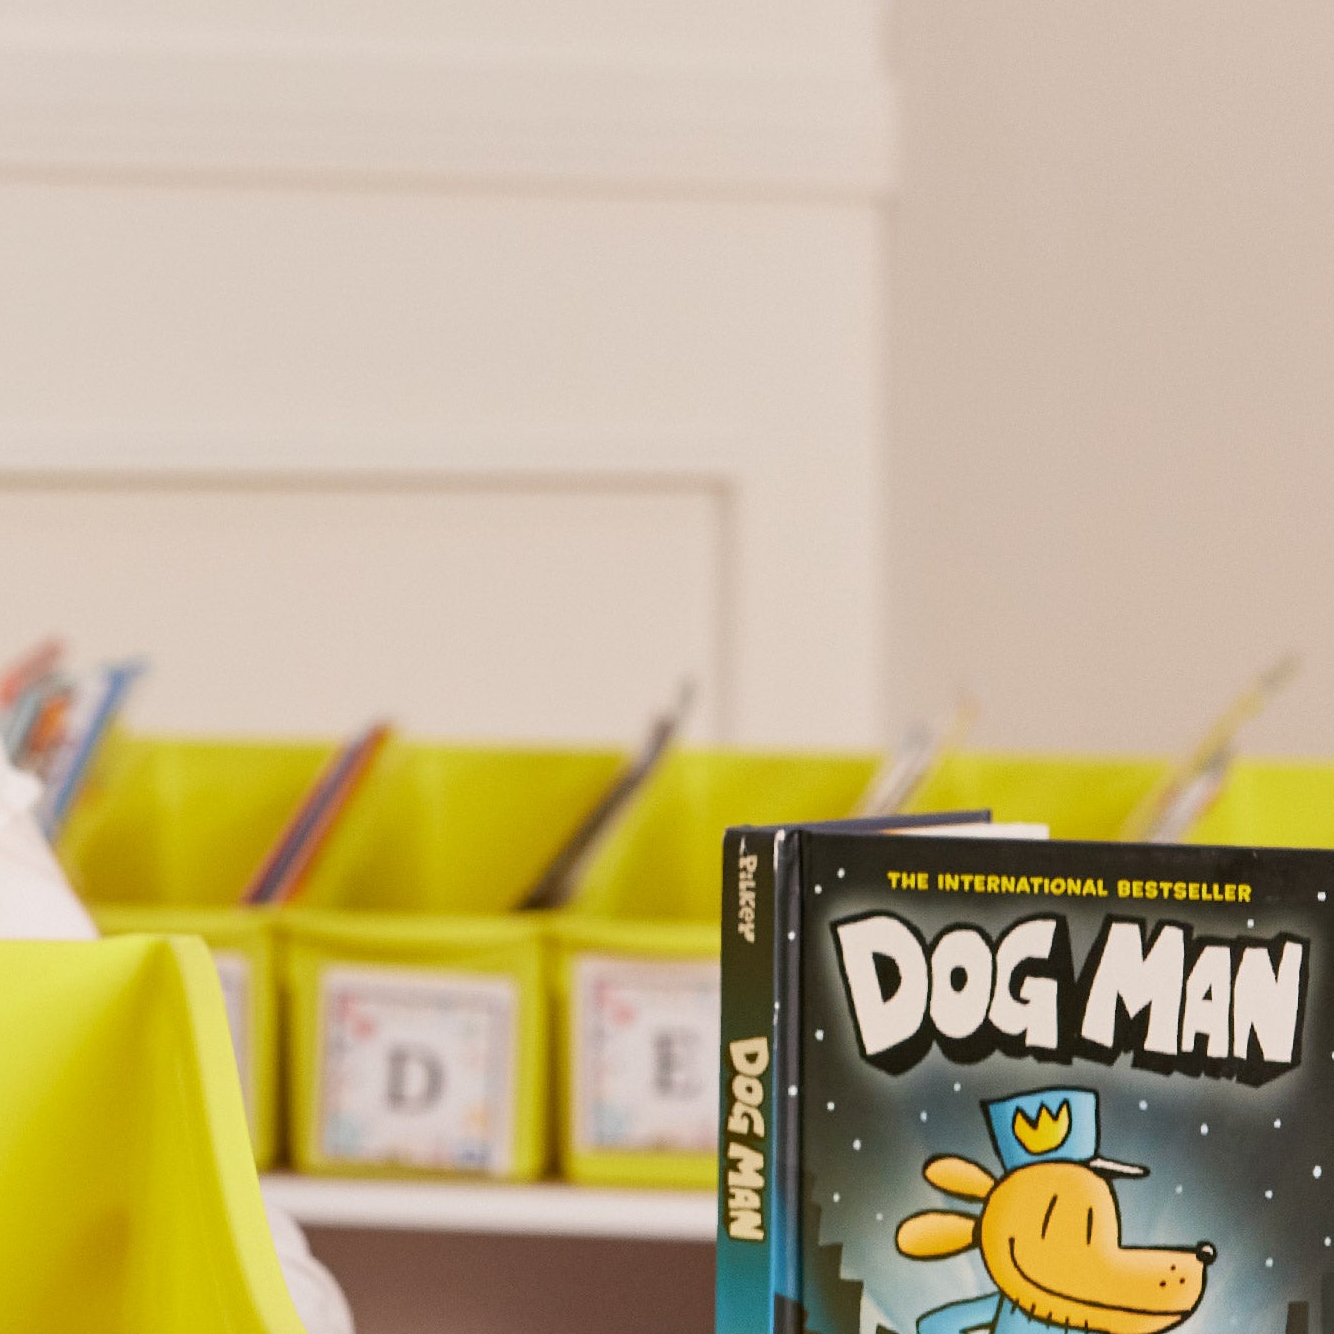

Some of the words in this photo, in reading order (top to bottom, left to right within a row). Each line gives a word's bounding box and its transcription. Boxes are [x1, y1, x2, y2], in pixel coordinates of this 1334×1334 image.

[888, 872, 929, 892] THE
[937, 873, 1108, 898] INTERNATIONAL
[1117, 880, 1253, 903] BESTSELLER
[836, 916, 1058, 1057] DOG
[1081, 919, 1304, 1064] MAN
[386, 1049, 445, 1111] D
[728, 1036, 769, 1138] DOG
[728, 1141, 765, 1241] MAN
